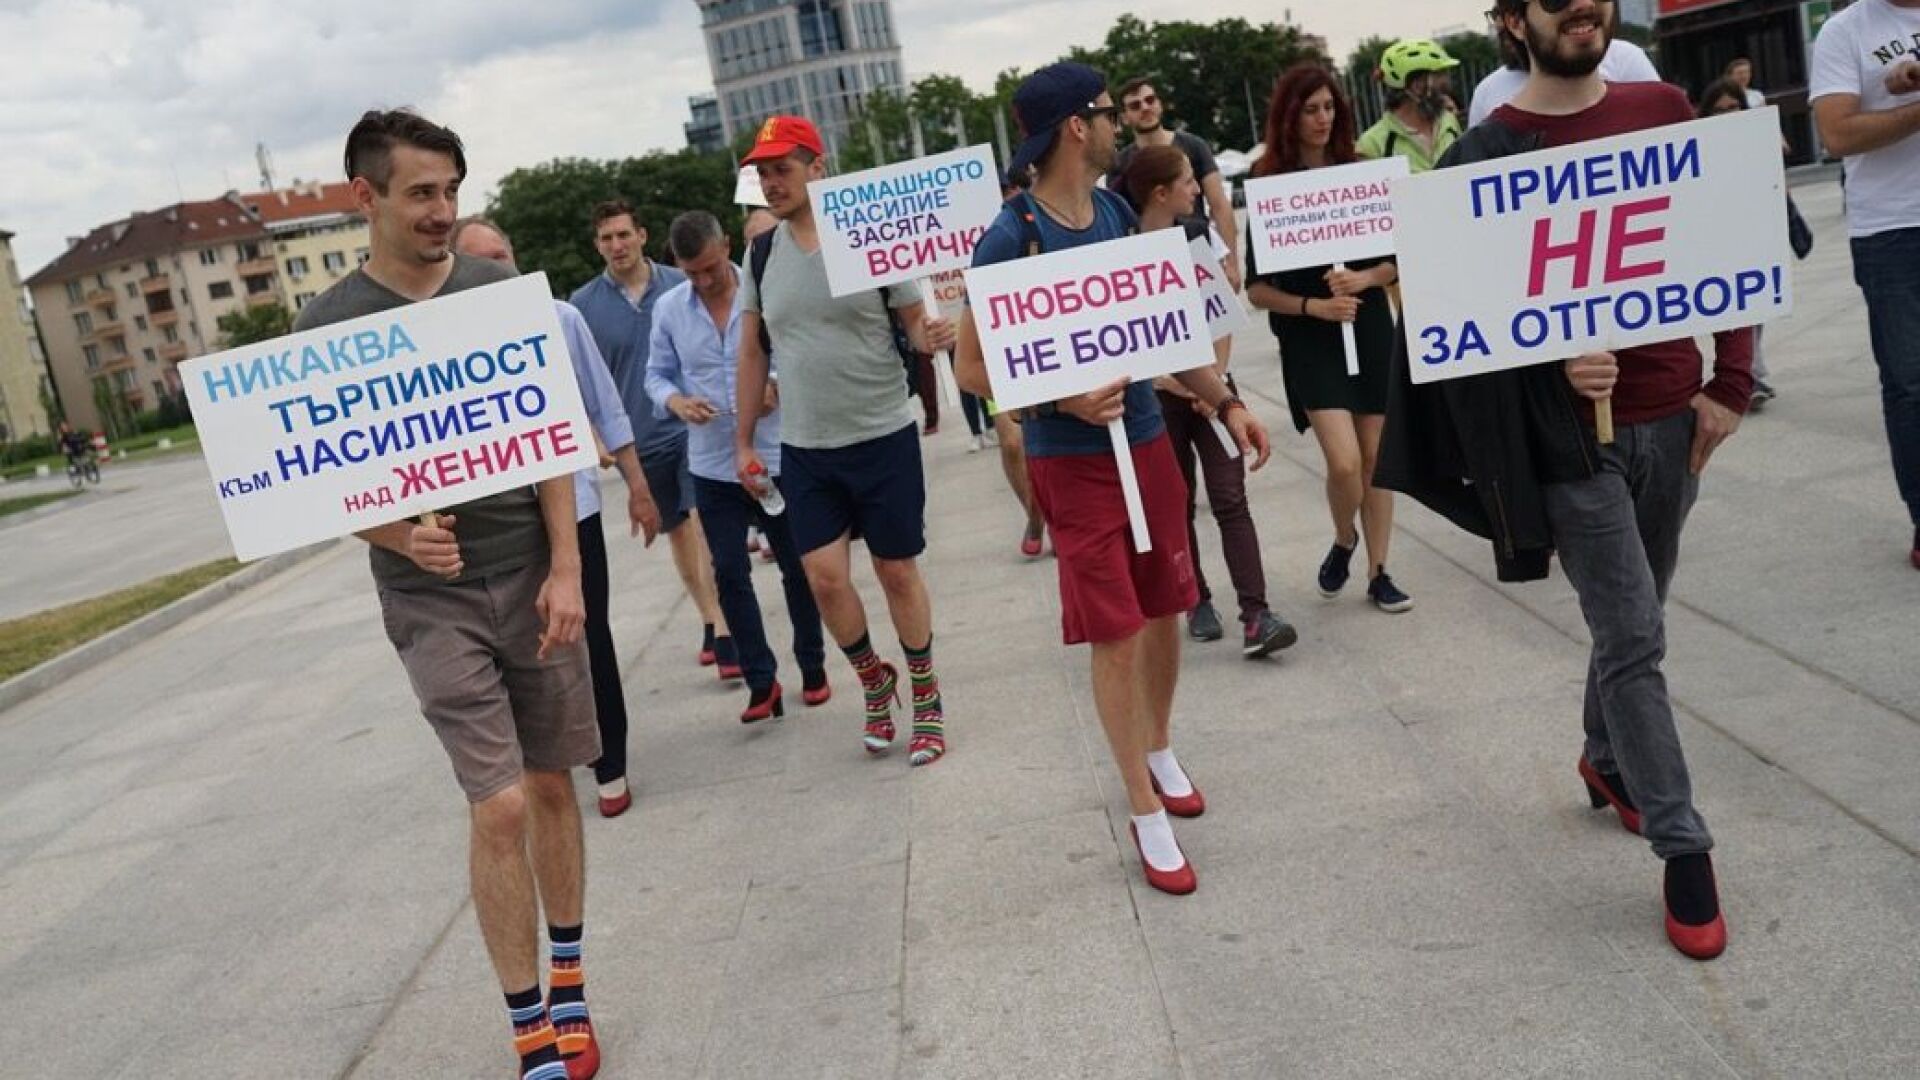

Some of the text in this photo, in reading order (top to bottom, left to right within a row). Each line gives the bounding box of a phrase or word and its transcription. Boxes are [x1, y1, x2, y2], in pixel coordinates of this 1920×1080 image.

[822, 159, 983, 216] ДОМАШНОТО
[833, 188, 950, 231] НАСИЛИЕ
[1256, 196, 1284, 216] НЕ
[1470, 138, 1701, 219] ПРИЕМИ
[847, 213, 943, 249] ЗАСЯГА
[867, 225, 985, 277] ВСИЧК
[1264, 209, 1327, 230] ИЗПРАВИ
[1330, 206, 1346, 220] СЕ
[1269, 216, 1394, 249] НАСИЛИЕТО
[1526, 195, 1672, 298] НЕ
[988, 259, 1187, 330] ЛЮБОВТА
[1419, 265, 1783, 365] ЗА ОТГОВОР!
[201, 322, 418, 403] НИКАКВА
[1004, 309, 1191, 379] НЕ БОЛИ!
[268, 333, 549, 435] ТЪРПИМОСТ
[274, 384, 547, 482] НАСИЛИЕТО
[343, 420, 580, 514] НАД ЖЕНИТЕ
